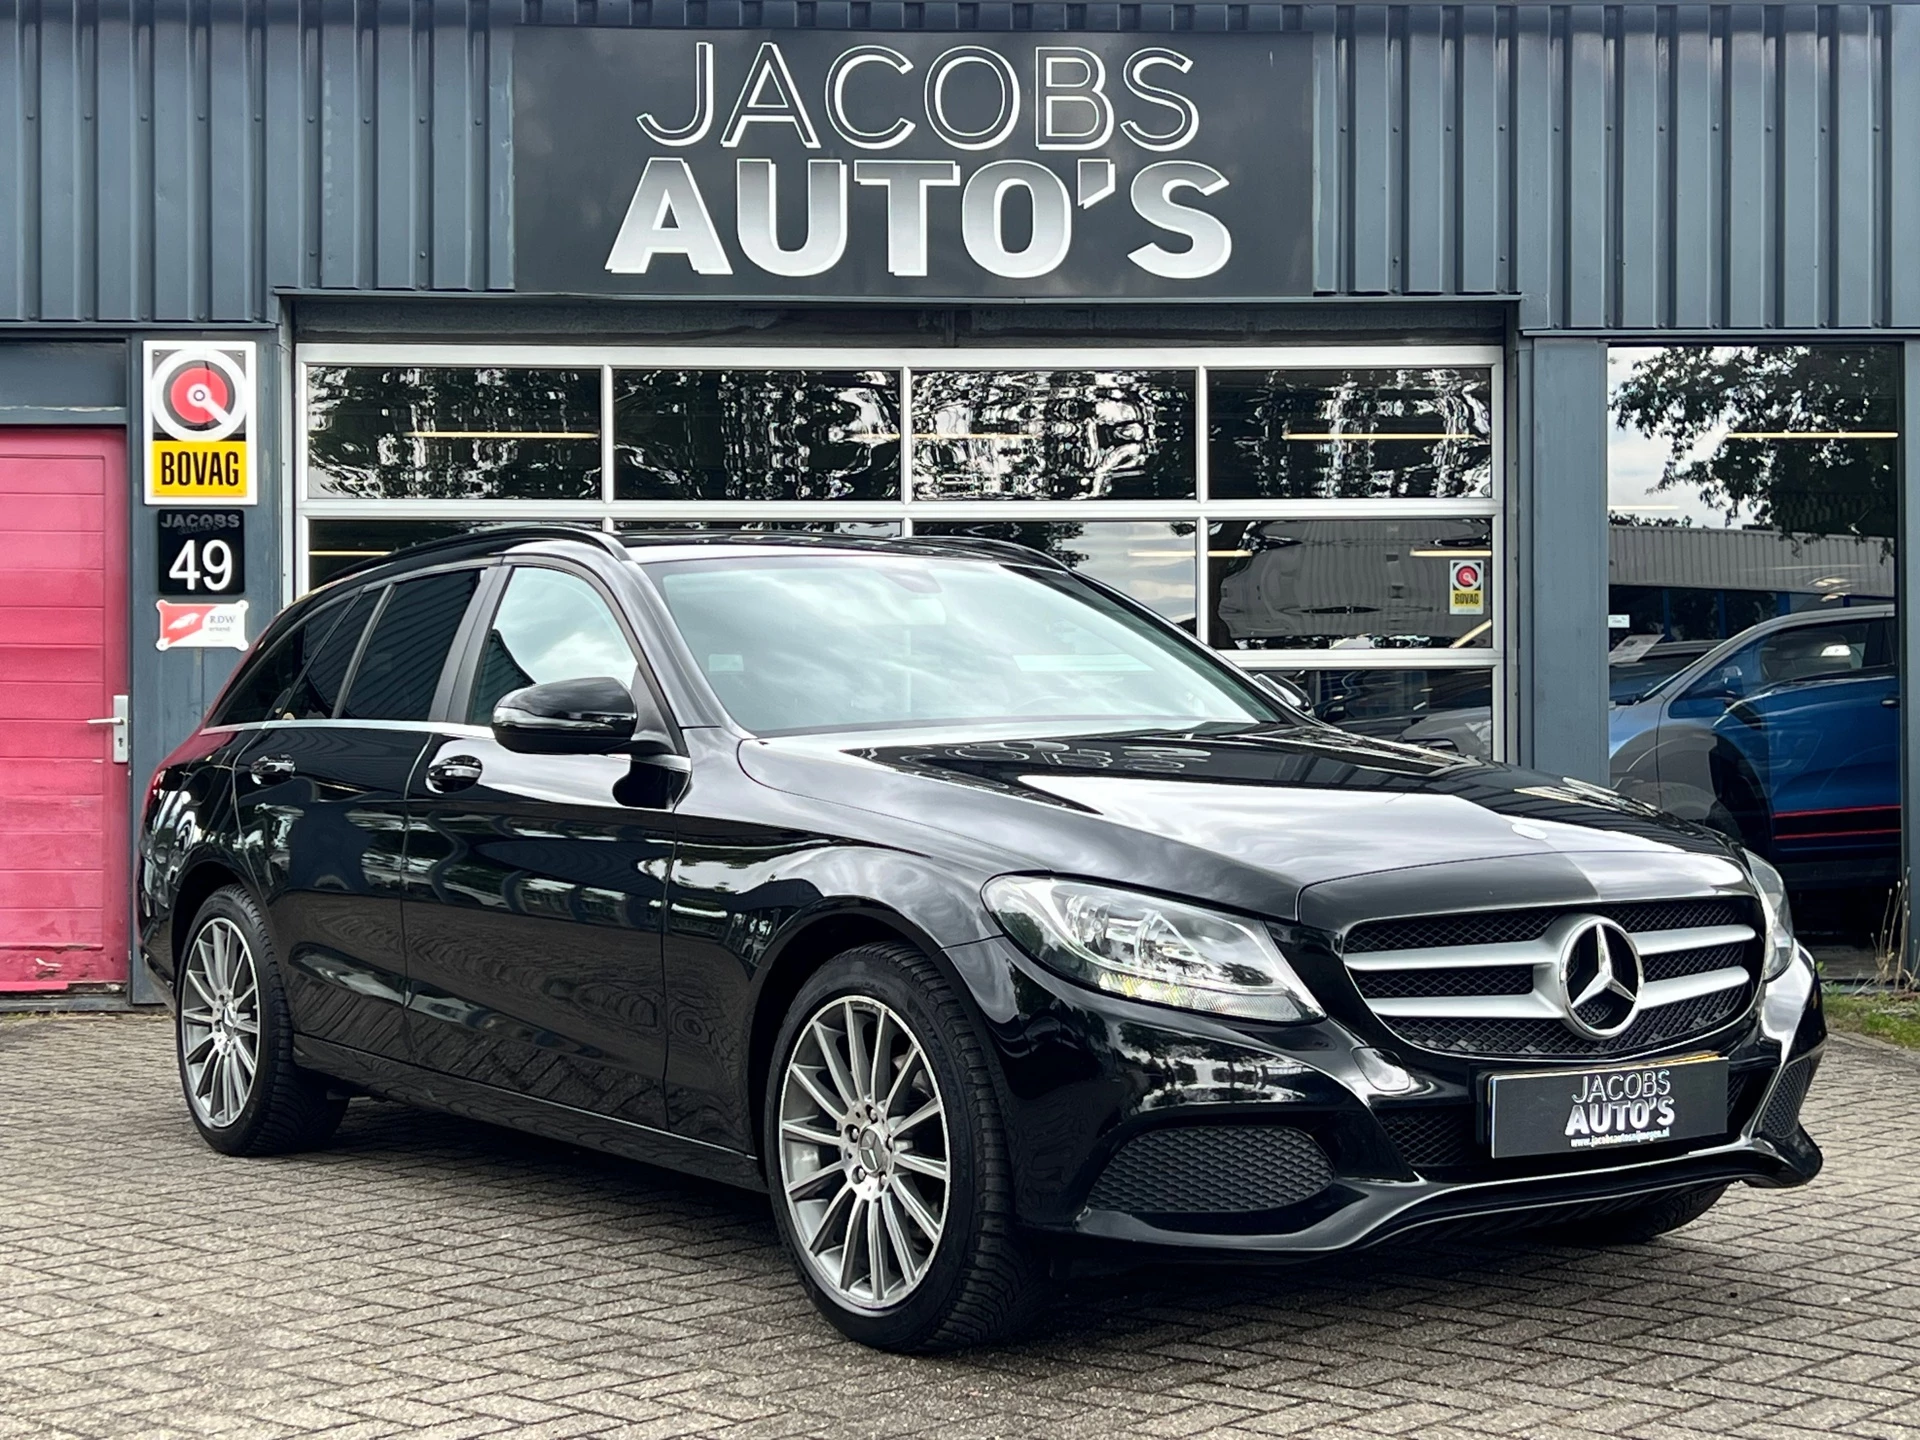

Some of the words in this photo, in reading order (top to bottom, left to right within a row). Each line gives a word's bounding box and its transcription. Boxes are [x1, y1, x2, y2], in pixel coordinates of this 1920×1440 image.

[636, 41, 1200, 152] JACOBS
[604, 157, 1232, 279] AUTO'S
[161, 451, 239, 486] BOVAG
[161, 514, 240, 528] JACOBS
[168, 539, 233, 591] 49
[1455, 593, 1479, 604] BOVAG
[210, 615, 236, 624] RDW
[1571, 1070, 1671, 1103] JACOBS
[1564, 1095, 1676, 1136] AUTO'S
